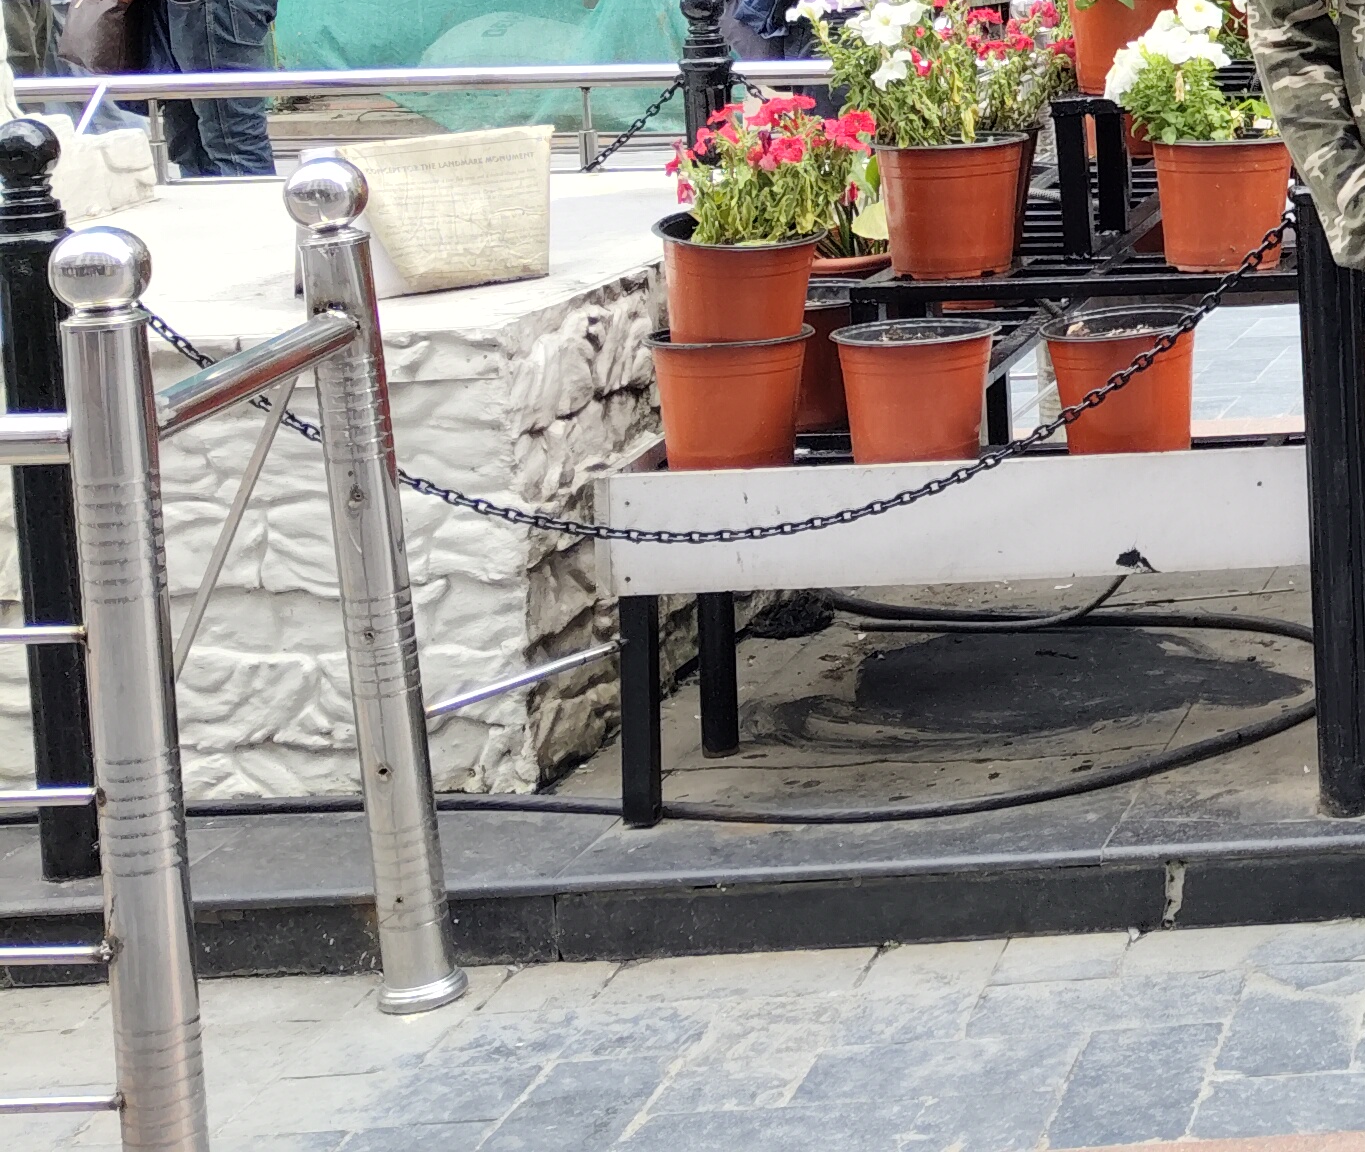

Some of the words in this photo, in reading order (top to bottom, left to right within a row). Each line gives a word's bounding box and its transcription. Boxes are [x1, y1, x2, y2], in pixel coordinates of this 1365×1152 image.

[421, 162, 436, 171] THE
[438, 157, 483, 169] LANDMARK
[485, 151, 534, 164] MONUMENT
